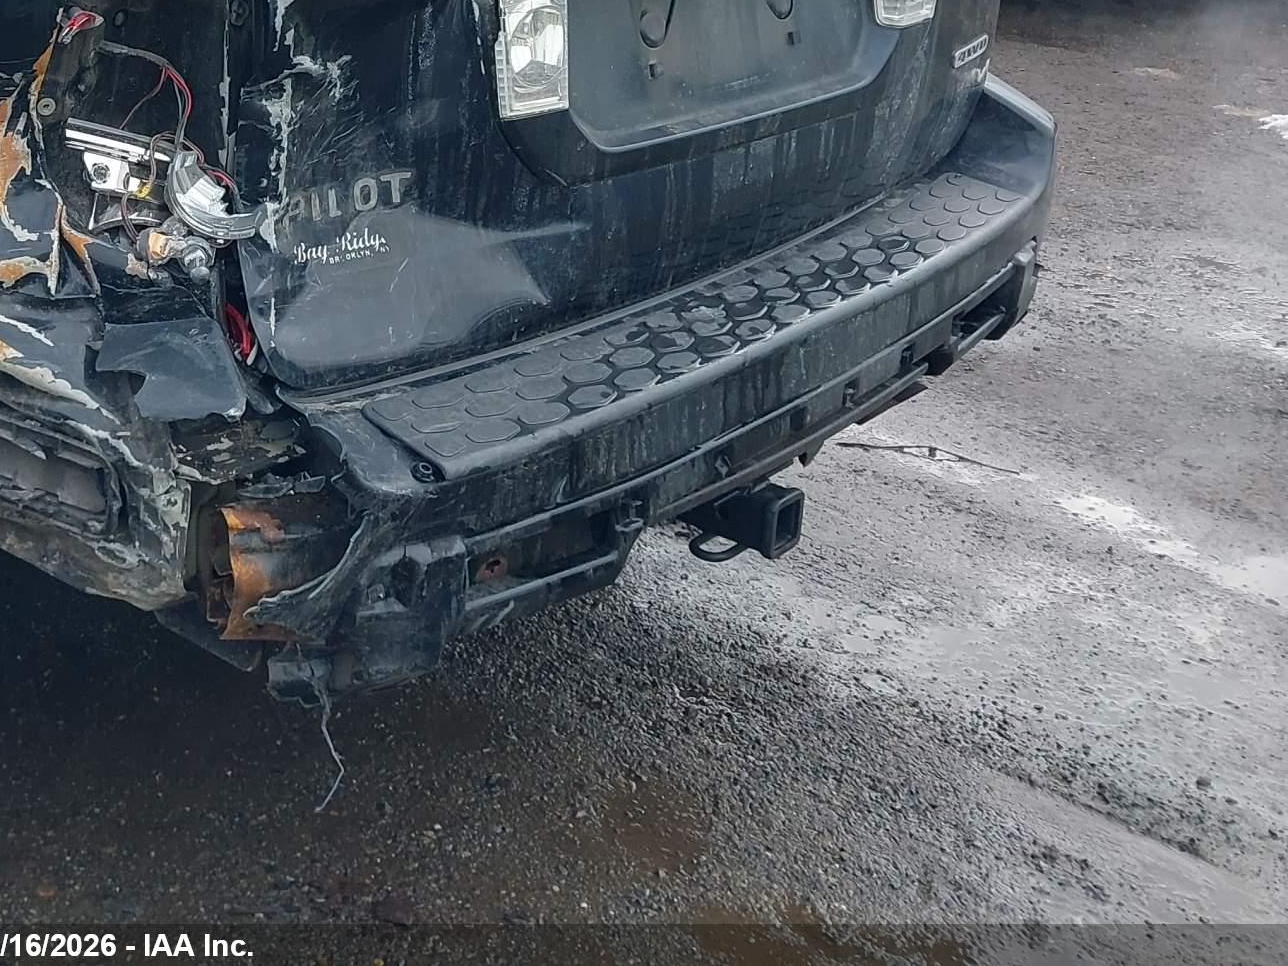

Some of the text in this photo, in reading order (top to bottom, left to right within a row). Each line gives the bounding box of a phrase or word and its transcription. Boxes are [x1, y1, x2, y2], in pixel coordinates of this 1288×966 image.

[956, 35, 988, 64] 4WD
[283, 171, 412, 230] PILOT
[293, 242, 328, 265] Bay
